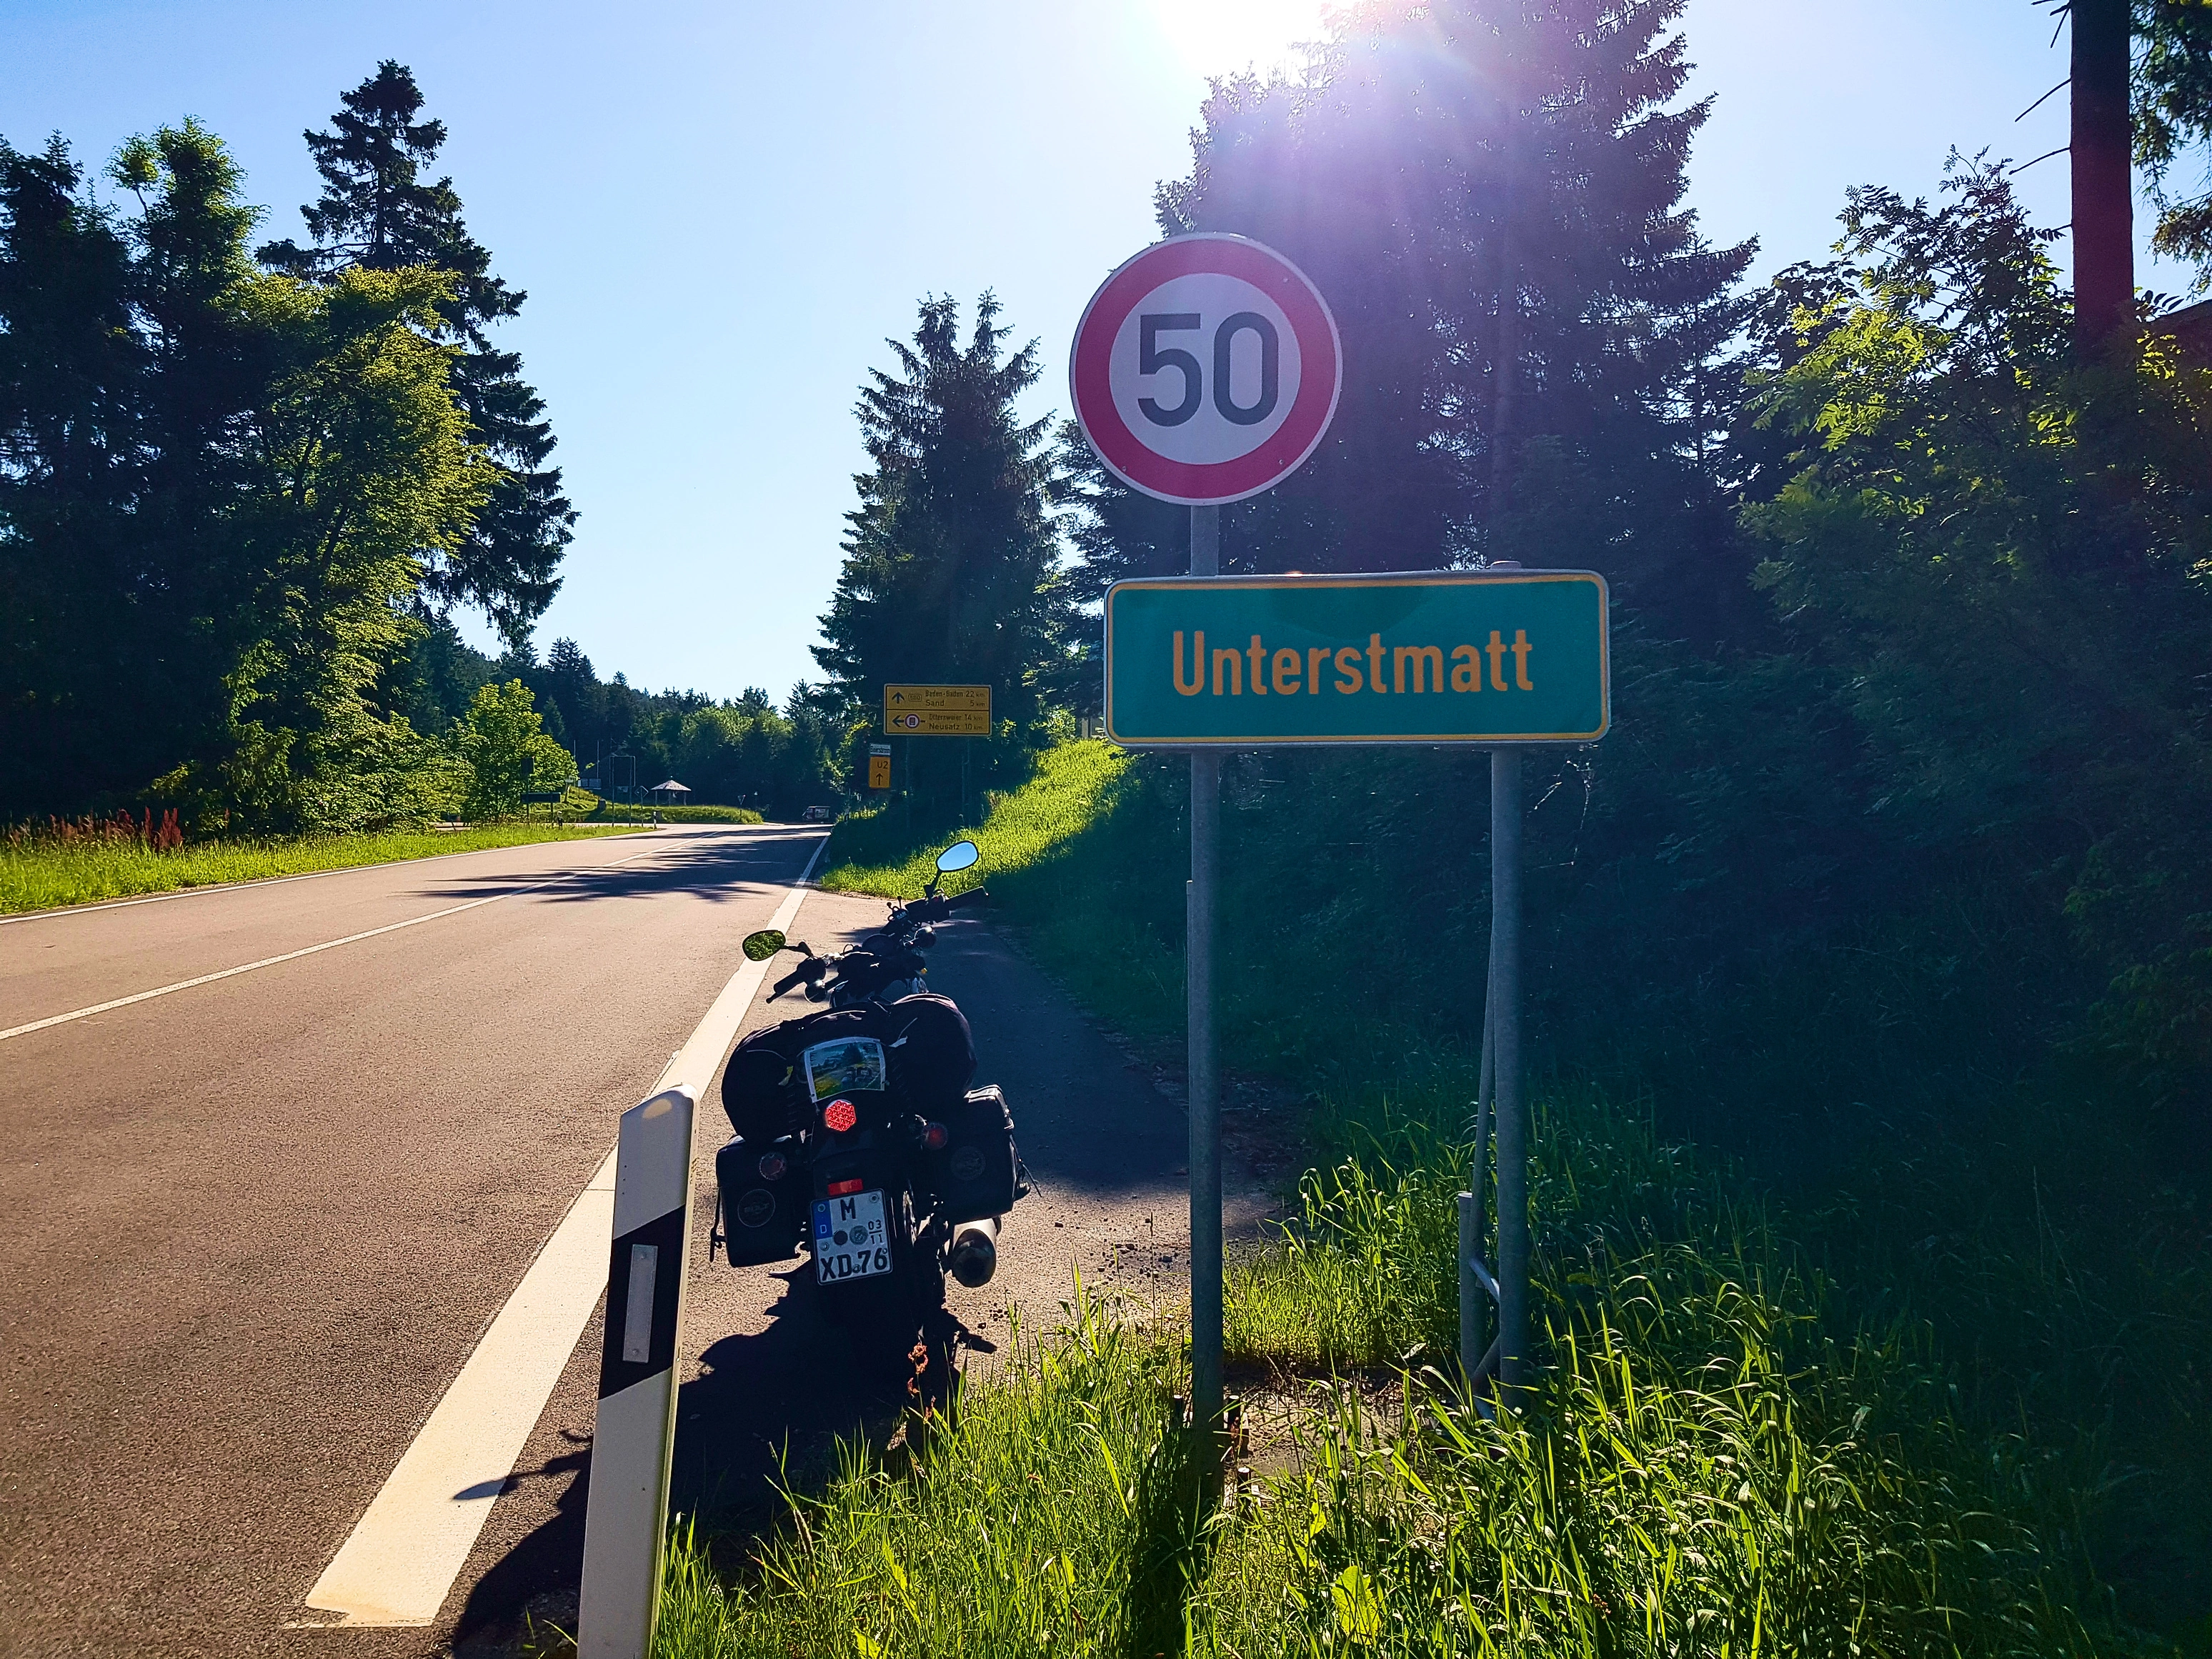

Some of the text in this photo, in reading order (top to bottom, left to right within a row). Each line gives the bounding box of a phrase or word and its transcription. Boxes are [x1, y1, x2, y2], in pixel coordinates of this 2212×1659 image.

[1138, 312, 1279, 427] 50
[1172, 629, 1533, 697] Unterstmatt
[840, 1197, 856, 1221] M
[819, 1225, 827, 1234] D
[868, 1219, 882, 1230] 03
[870, 1234, 883, 1245] 11
[820, 1247, 887, 1281] XD 76
